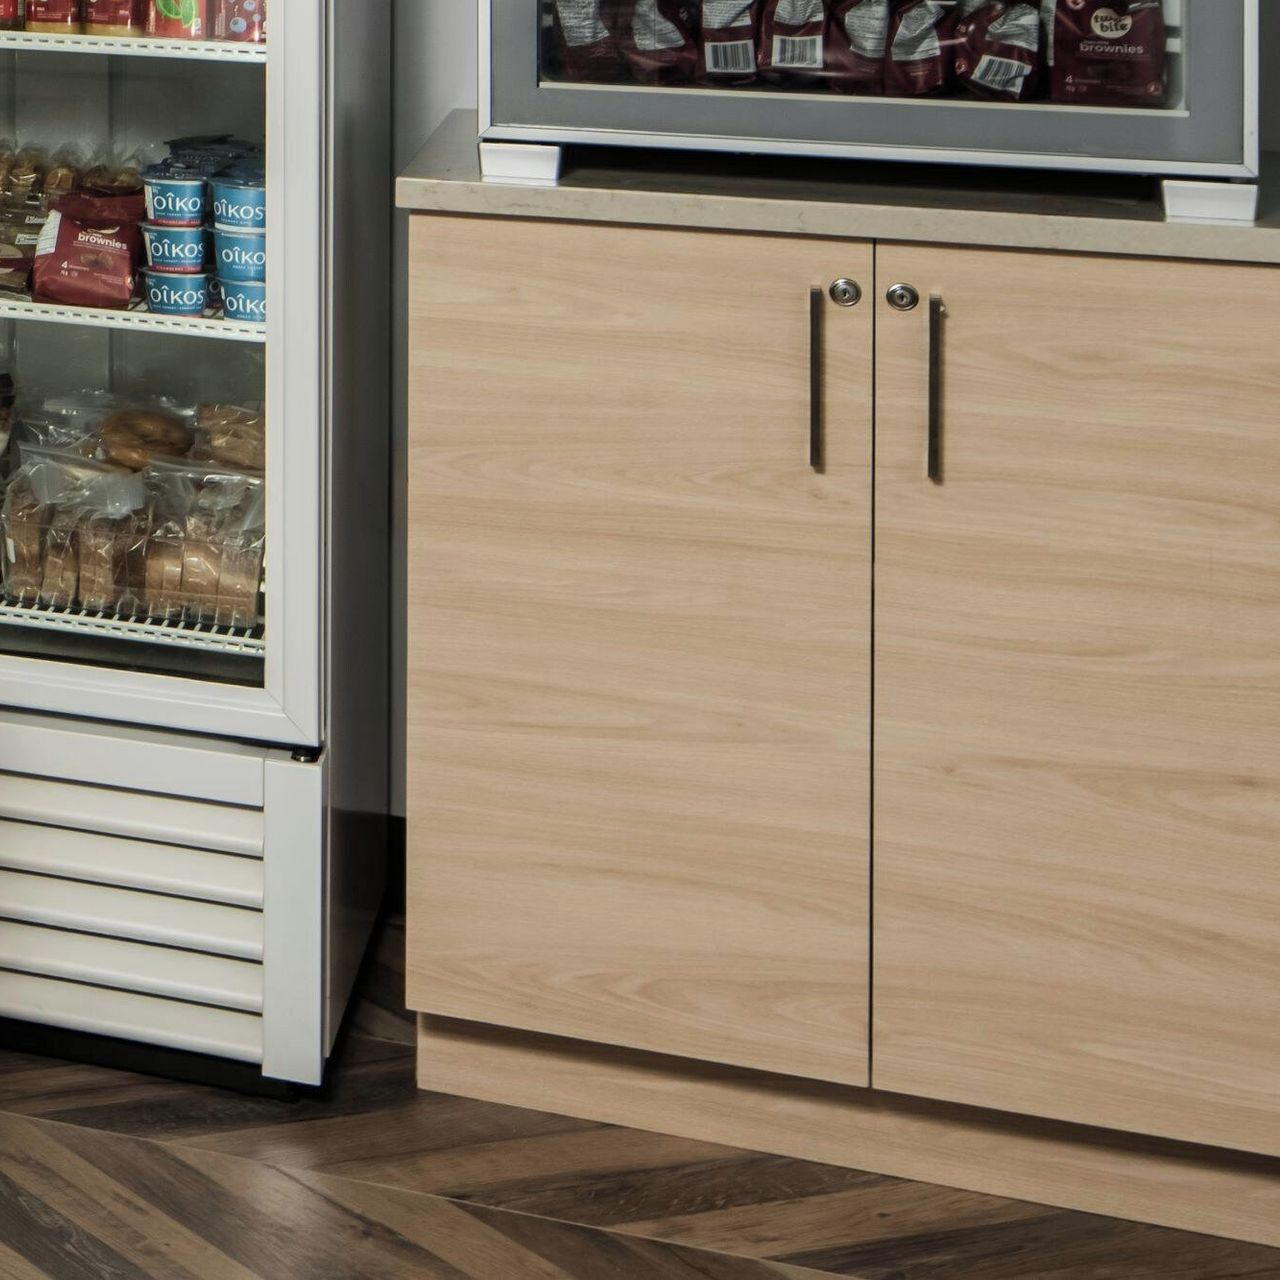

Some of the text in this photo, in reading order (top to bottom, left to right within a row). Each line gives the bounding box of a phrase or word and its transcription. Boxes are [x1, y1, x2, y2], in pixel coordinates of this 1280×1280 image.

[1100, 22, 1128, 32] bite
[1080, 42, 1144, 54] brownies
[153, 192, 202, 212] OÎKO
[78, 232, 128, 250] brownies
[61, 260, 68, 268] 4
